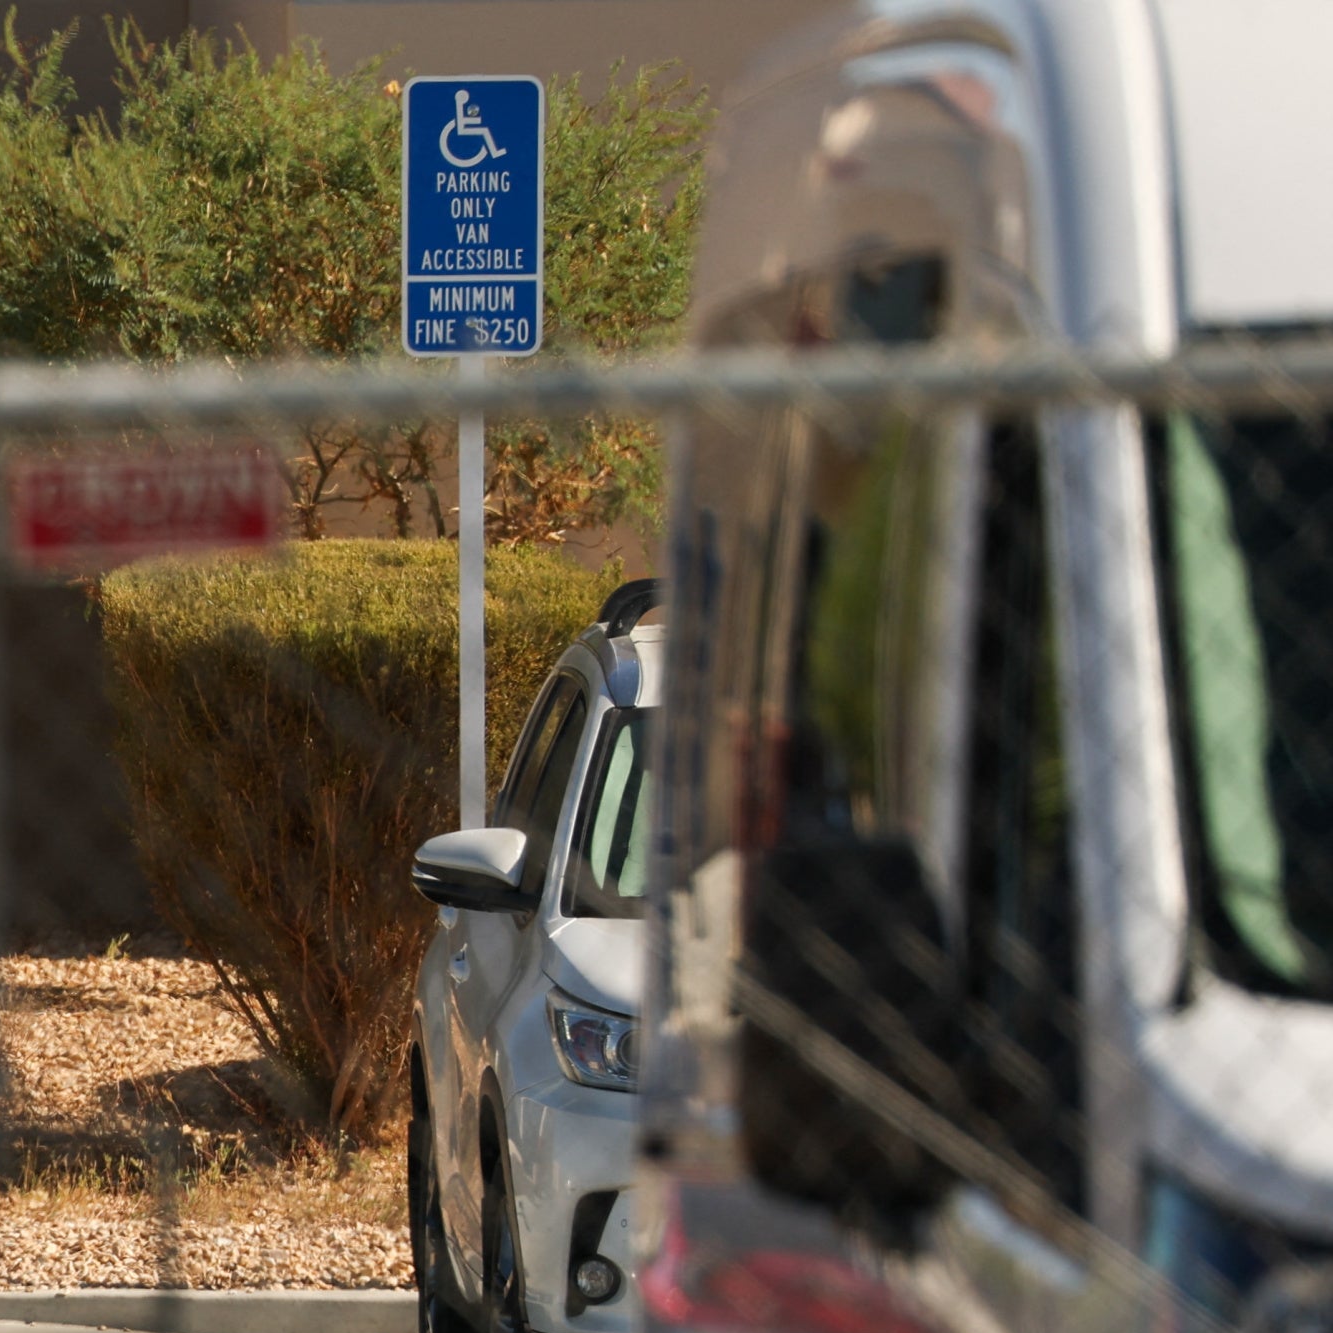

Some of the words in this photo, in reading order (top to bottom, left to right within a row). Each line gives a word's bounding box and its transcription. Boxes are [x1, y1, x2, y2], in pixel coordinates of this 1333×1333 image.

[436, 171, 510, 193] PARKING
[451, 198, 496, 218] ONLY
[456, 223, 489, 244] VAN
[421, 249, 524, 270] ACCESSIBLE
[429, 286, 515, 312] MINIMUM
[415, 319, 456, 344] FINE
[474, 317, 529, 345] $250
